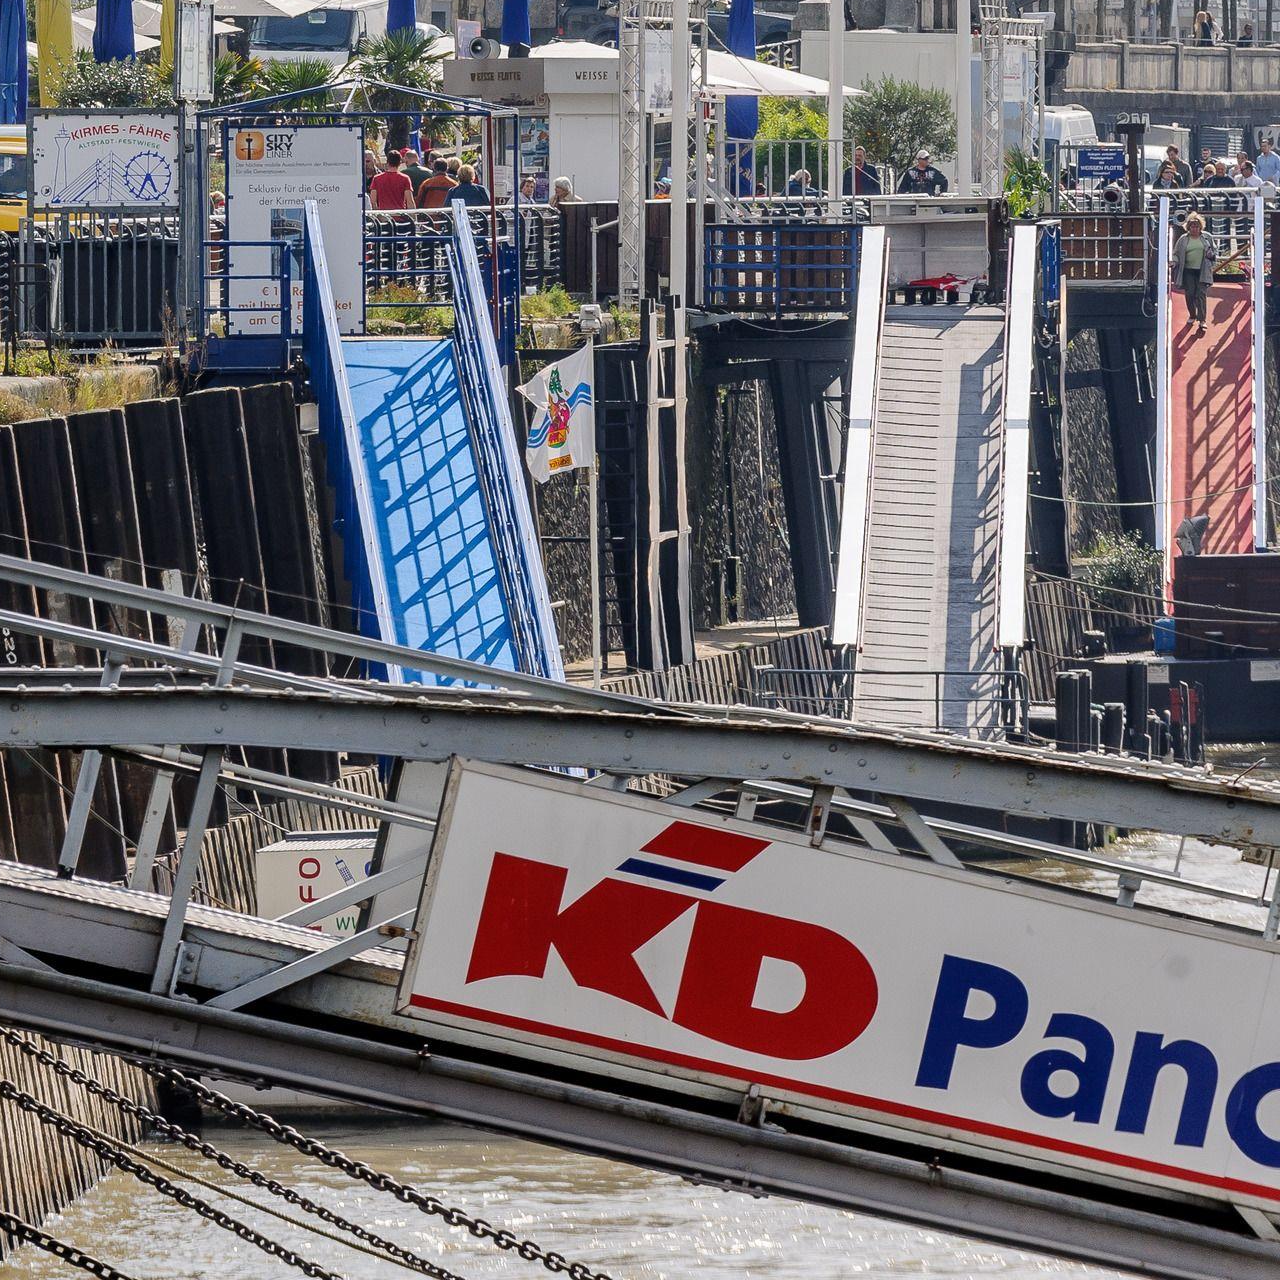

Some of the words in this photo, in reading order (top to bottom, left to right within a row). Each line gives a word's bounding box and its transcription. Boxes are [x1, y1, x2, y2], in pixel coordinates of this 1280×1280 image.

[470, 71, 495, 81] WEISSE
[497, 71, 522, 81] FLOTTE
[575, 71, 608, 80] WEISSE
[70, 124, 119, 141] KIRMES
[128, 123, 172, 142] FÄHRE
[265, 133, 294, 143] CITY
[266, 142, 293, 151] SKY
[266, 151, 293, 159] LINER
[248, 184, 282, 193] Exklusiv
[284, 184, 296, 193] für
[298, 184, 312, 193] die
[314, 184, 340, 193] Gäste
[259, 197, 273, 206] der
[249, 317, 267, 325] am
[465, 852, 879, 1060] KD
